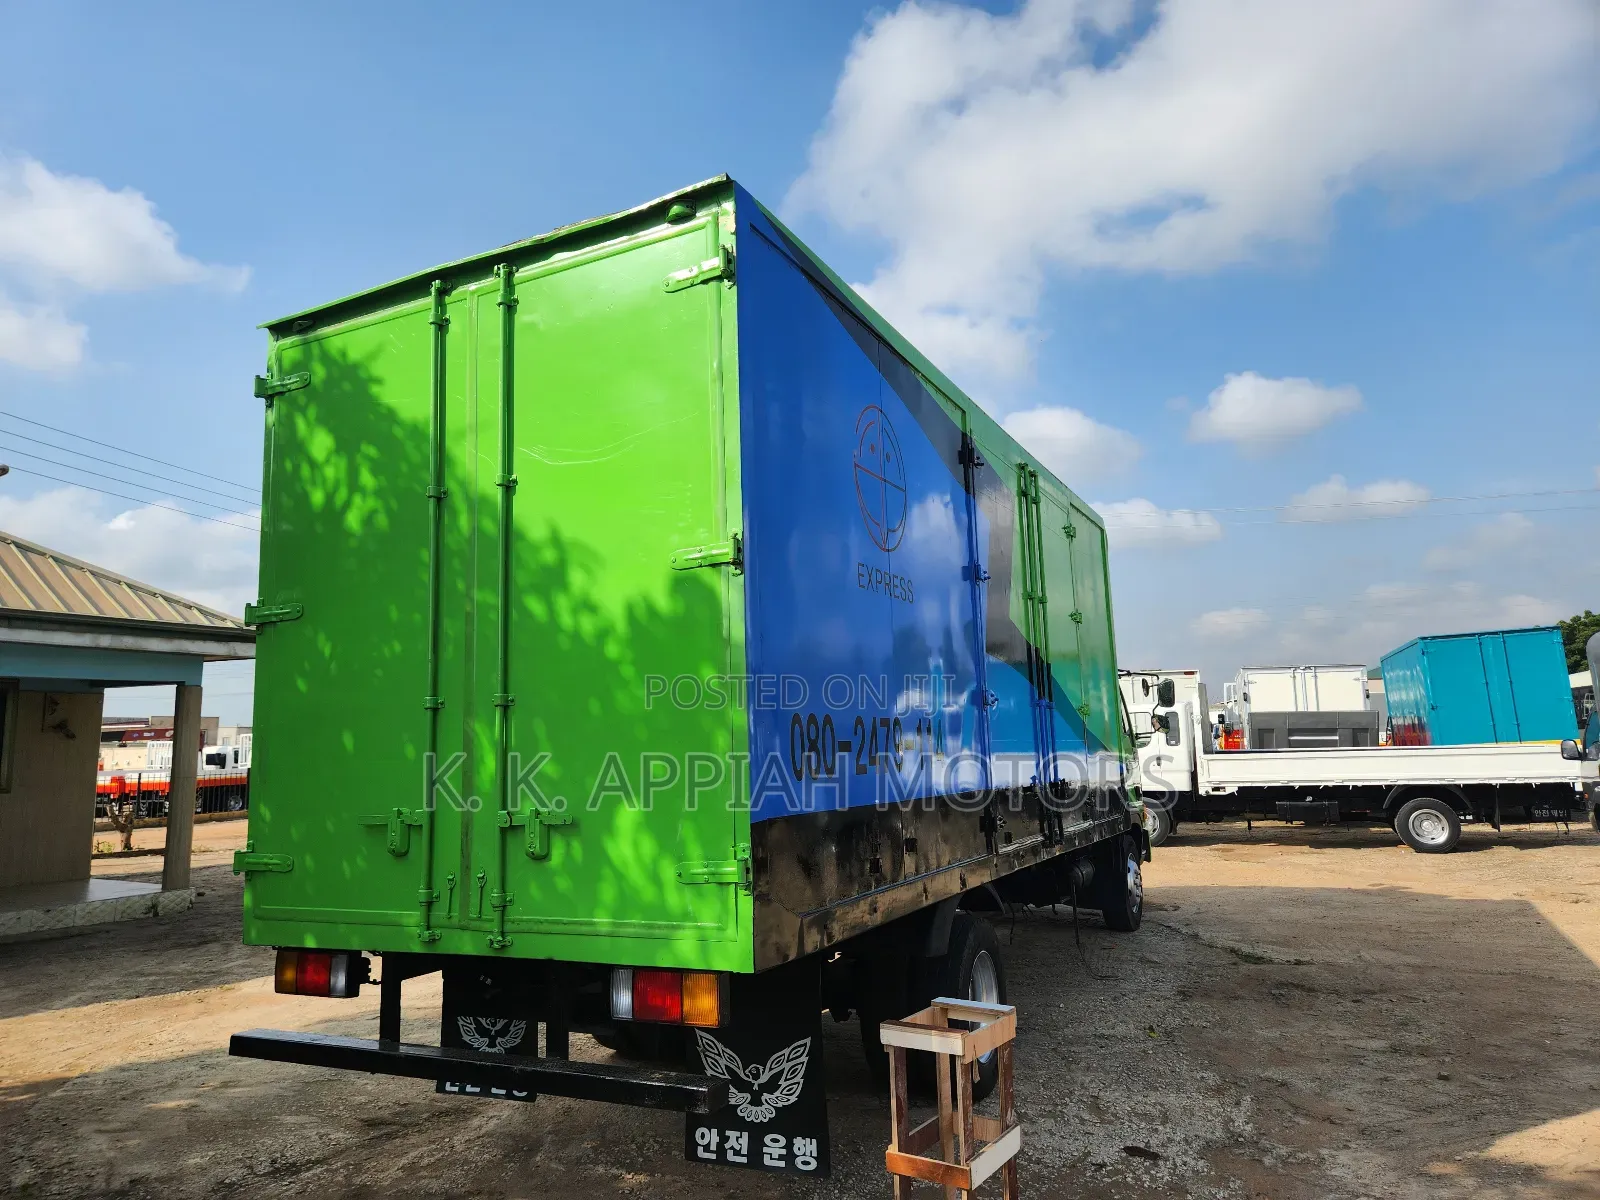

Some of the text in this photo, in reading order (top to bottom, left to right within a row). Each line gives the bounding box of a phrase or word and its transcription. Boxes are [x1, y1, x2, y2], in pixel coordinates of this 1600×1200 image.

[857, 562, 914, 604] EXPRESS
[695, 1127, 818, 1171] 안전 운행
